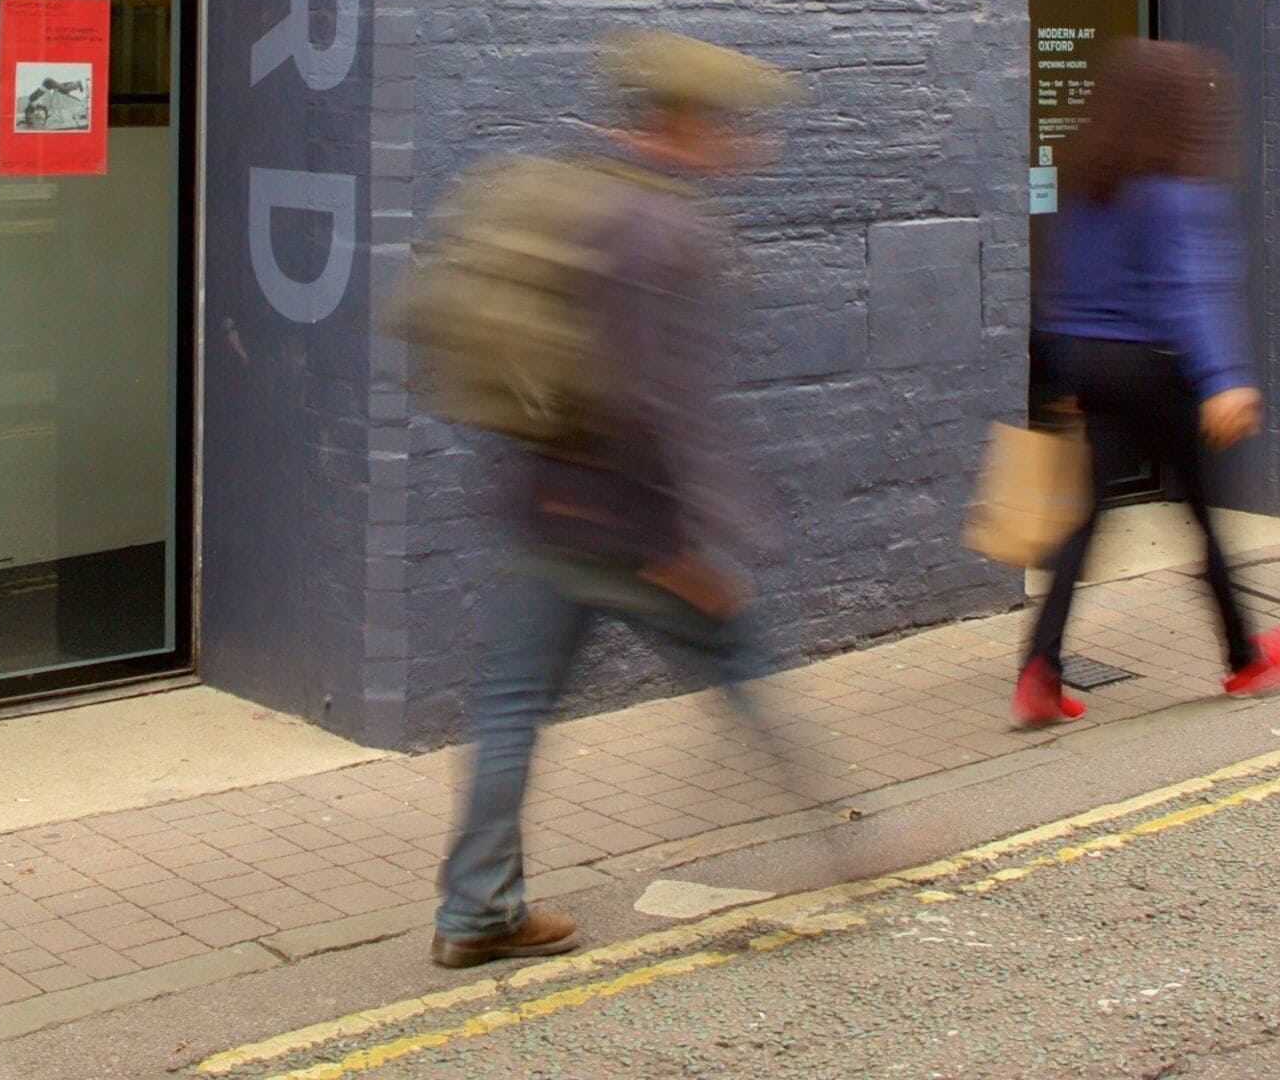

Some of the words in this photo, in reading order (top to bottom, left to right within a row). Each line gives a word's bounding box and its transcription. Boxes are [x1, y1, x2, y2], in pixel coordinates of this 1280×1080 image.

[1038, 28, 1075, 39] MODERN
[1077, 28, 1096, 39] ART
[1038, 40, 1074, 51] OXFORD
